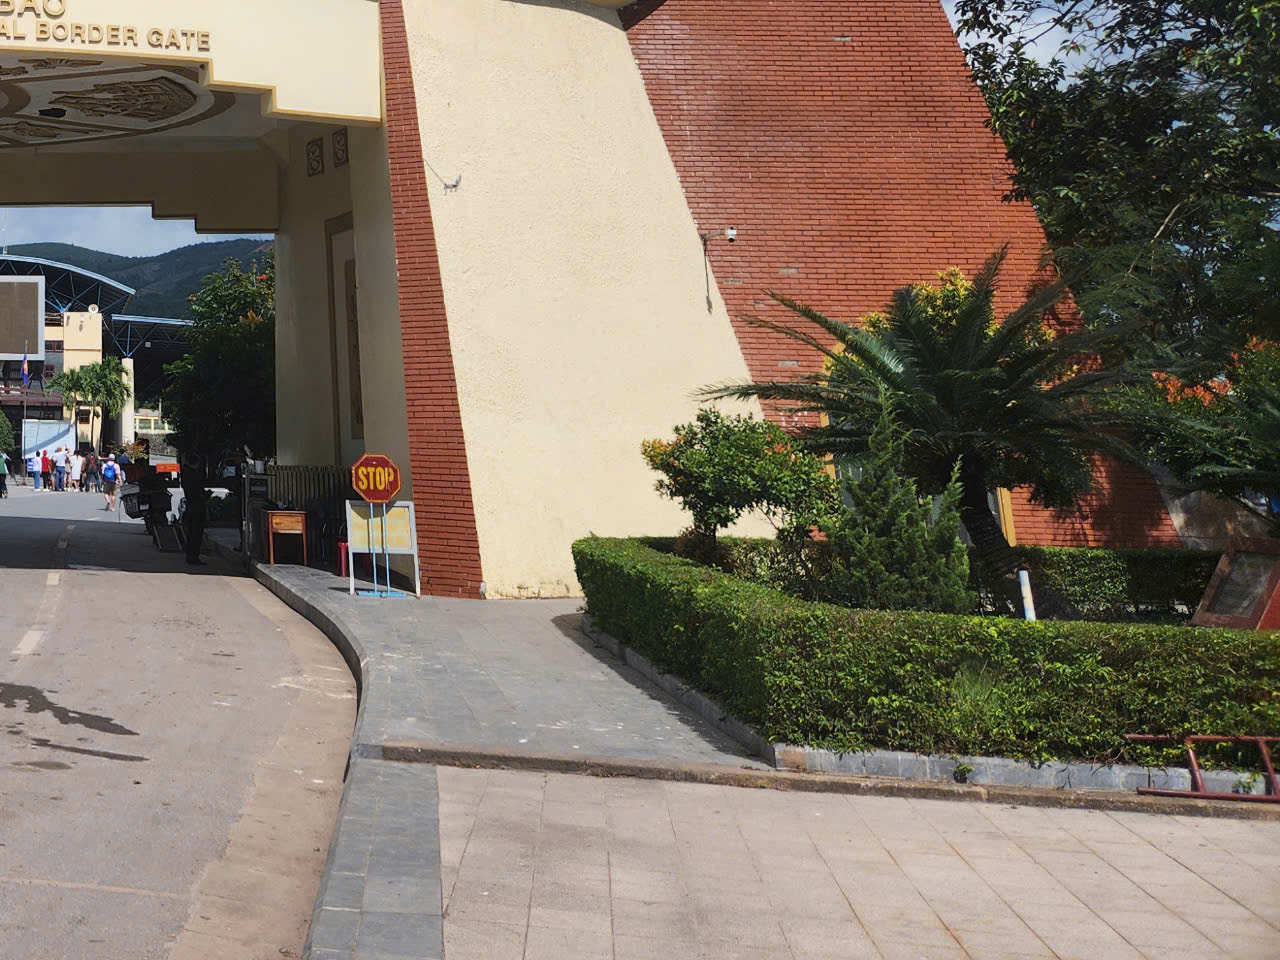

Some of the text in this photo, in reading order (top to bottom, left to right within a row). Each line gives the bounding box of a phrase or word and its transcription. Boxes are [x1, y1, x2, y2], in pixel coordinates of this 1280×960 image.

[36, 20, 138, 47] BORDER
[147, 28, 211, 51] GATE
[358, 466, 395, 491] STOP
